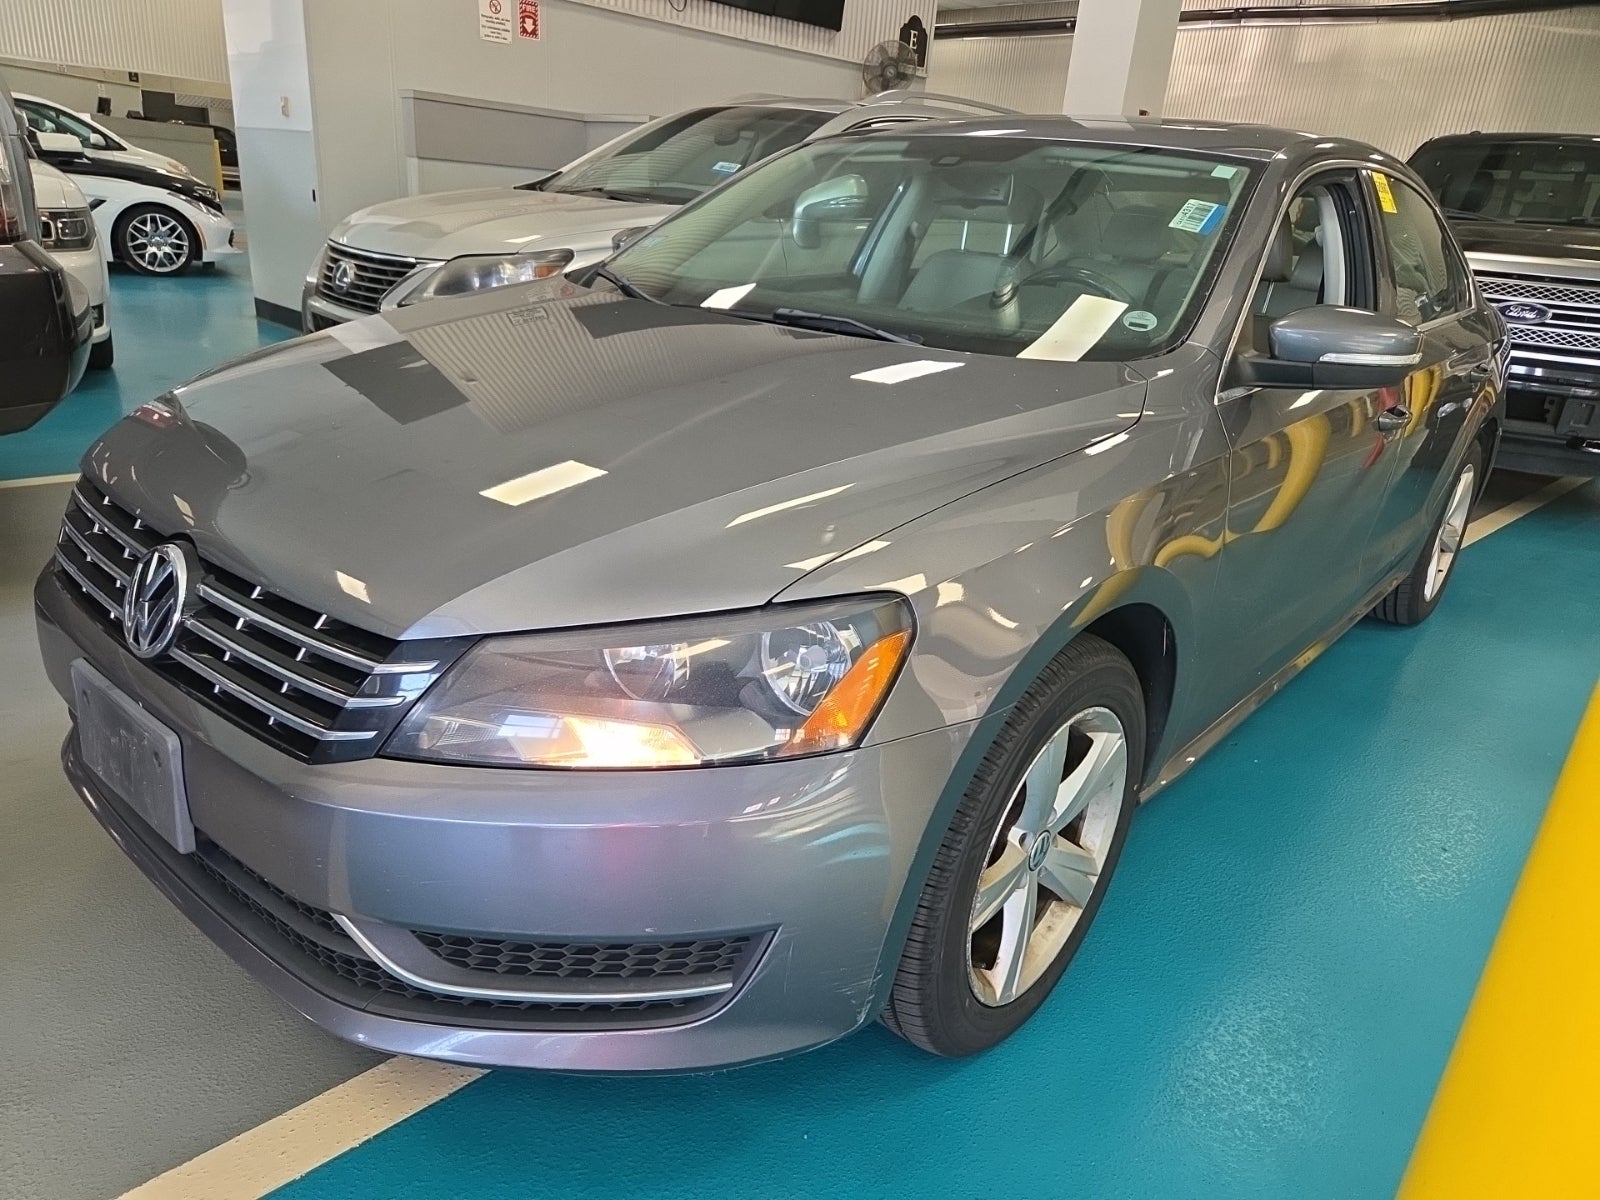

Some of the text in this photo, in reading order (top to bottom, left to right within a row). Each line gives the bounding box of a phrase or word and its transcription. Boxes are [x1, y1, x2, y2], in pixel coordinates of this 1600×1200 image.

[522, 4, 536, 13] FIRE
[910, 30, 918, 50] E
[1505, 304, 1538, 319] Ford
